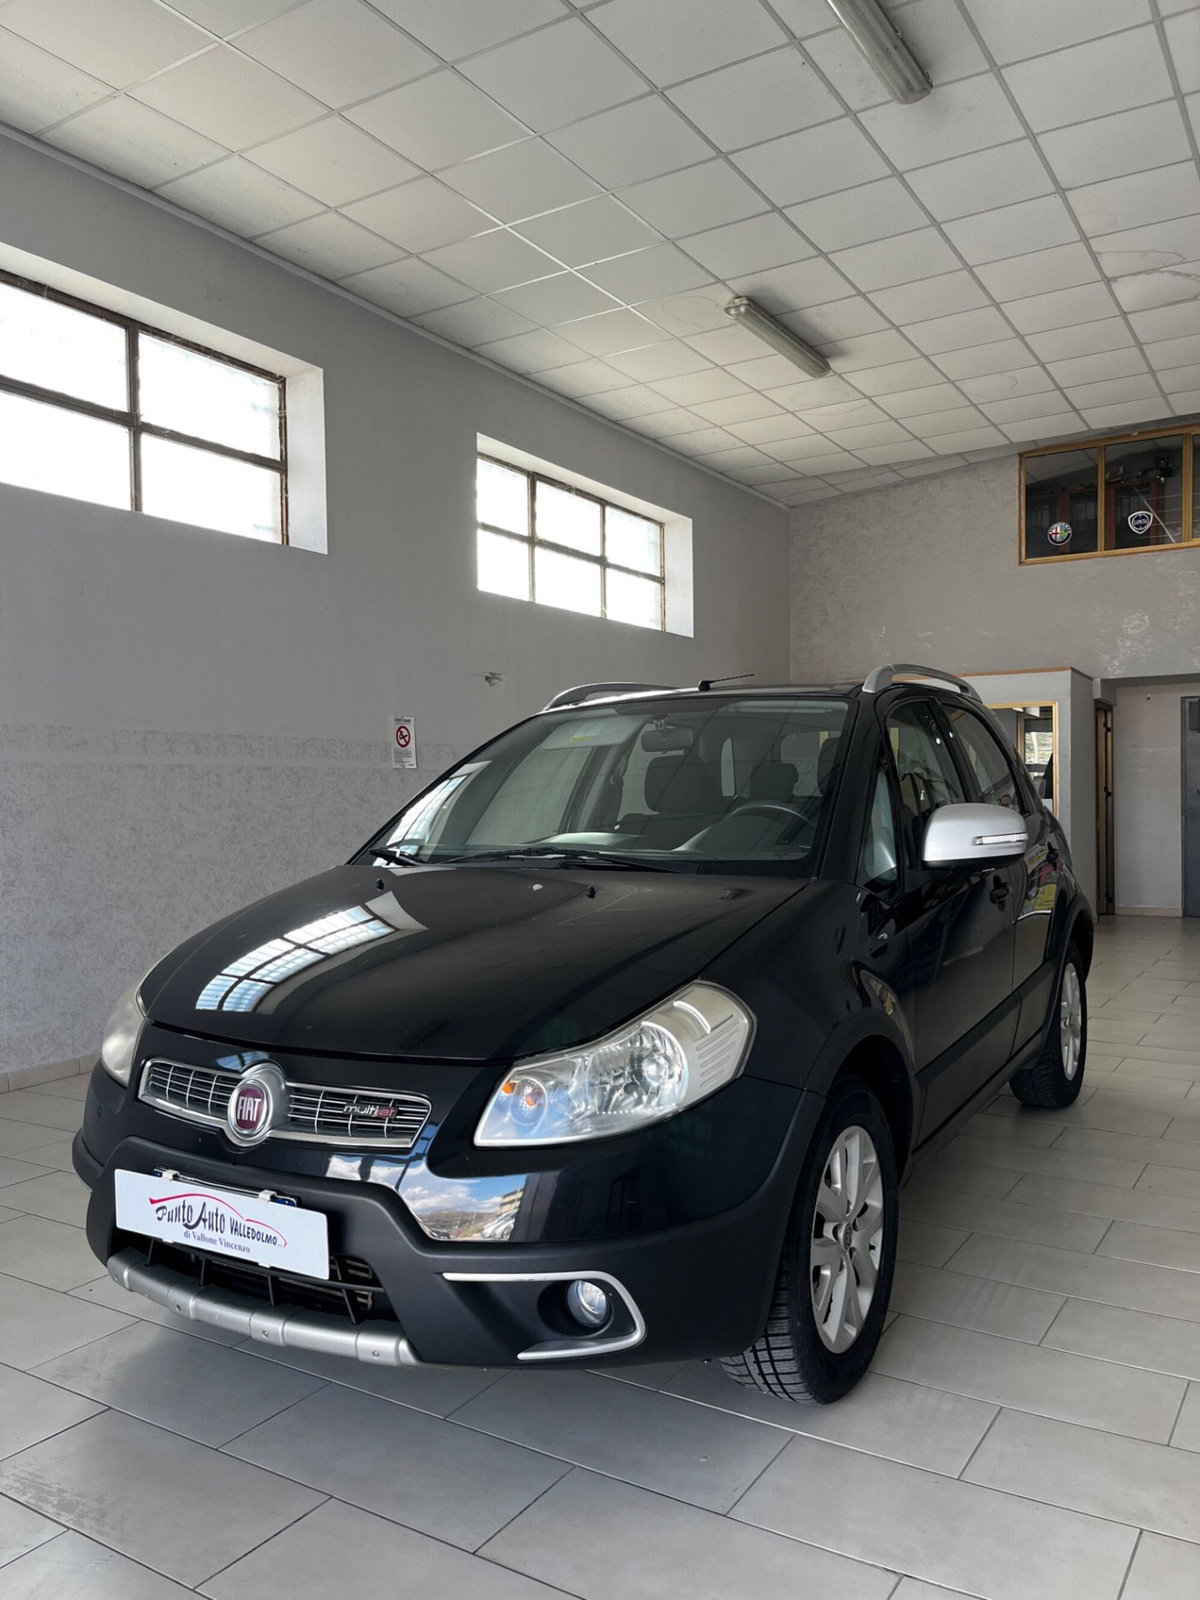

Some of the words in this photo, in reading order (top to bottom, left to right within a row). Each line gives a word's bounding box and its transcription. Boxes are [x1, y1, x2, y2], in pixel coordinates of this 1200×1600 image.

[236, 1096, 262, 1122] FIAT
[156, 1199, 193, 1224] Punto
[183, 1201, 226, 1234] Auto
[183, 1230, 191, 1239] di
[192, 1231, 218, 1246] Vallone
[218, 1237, 251, 1254] Vincenzo
